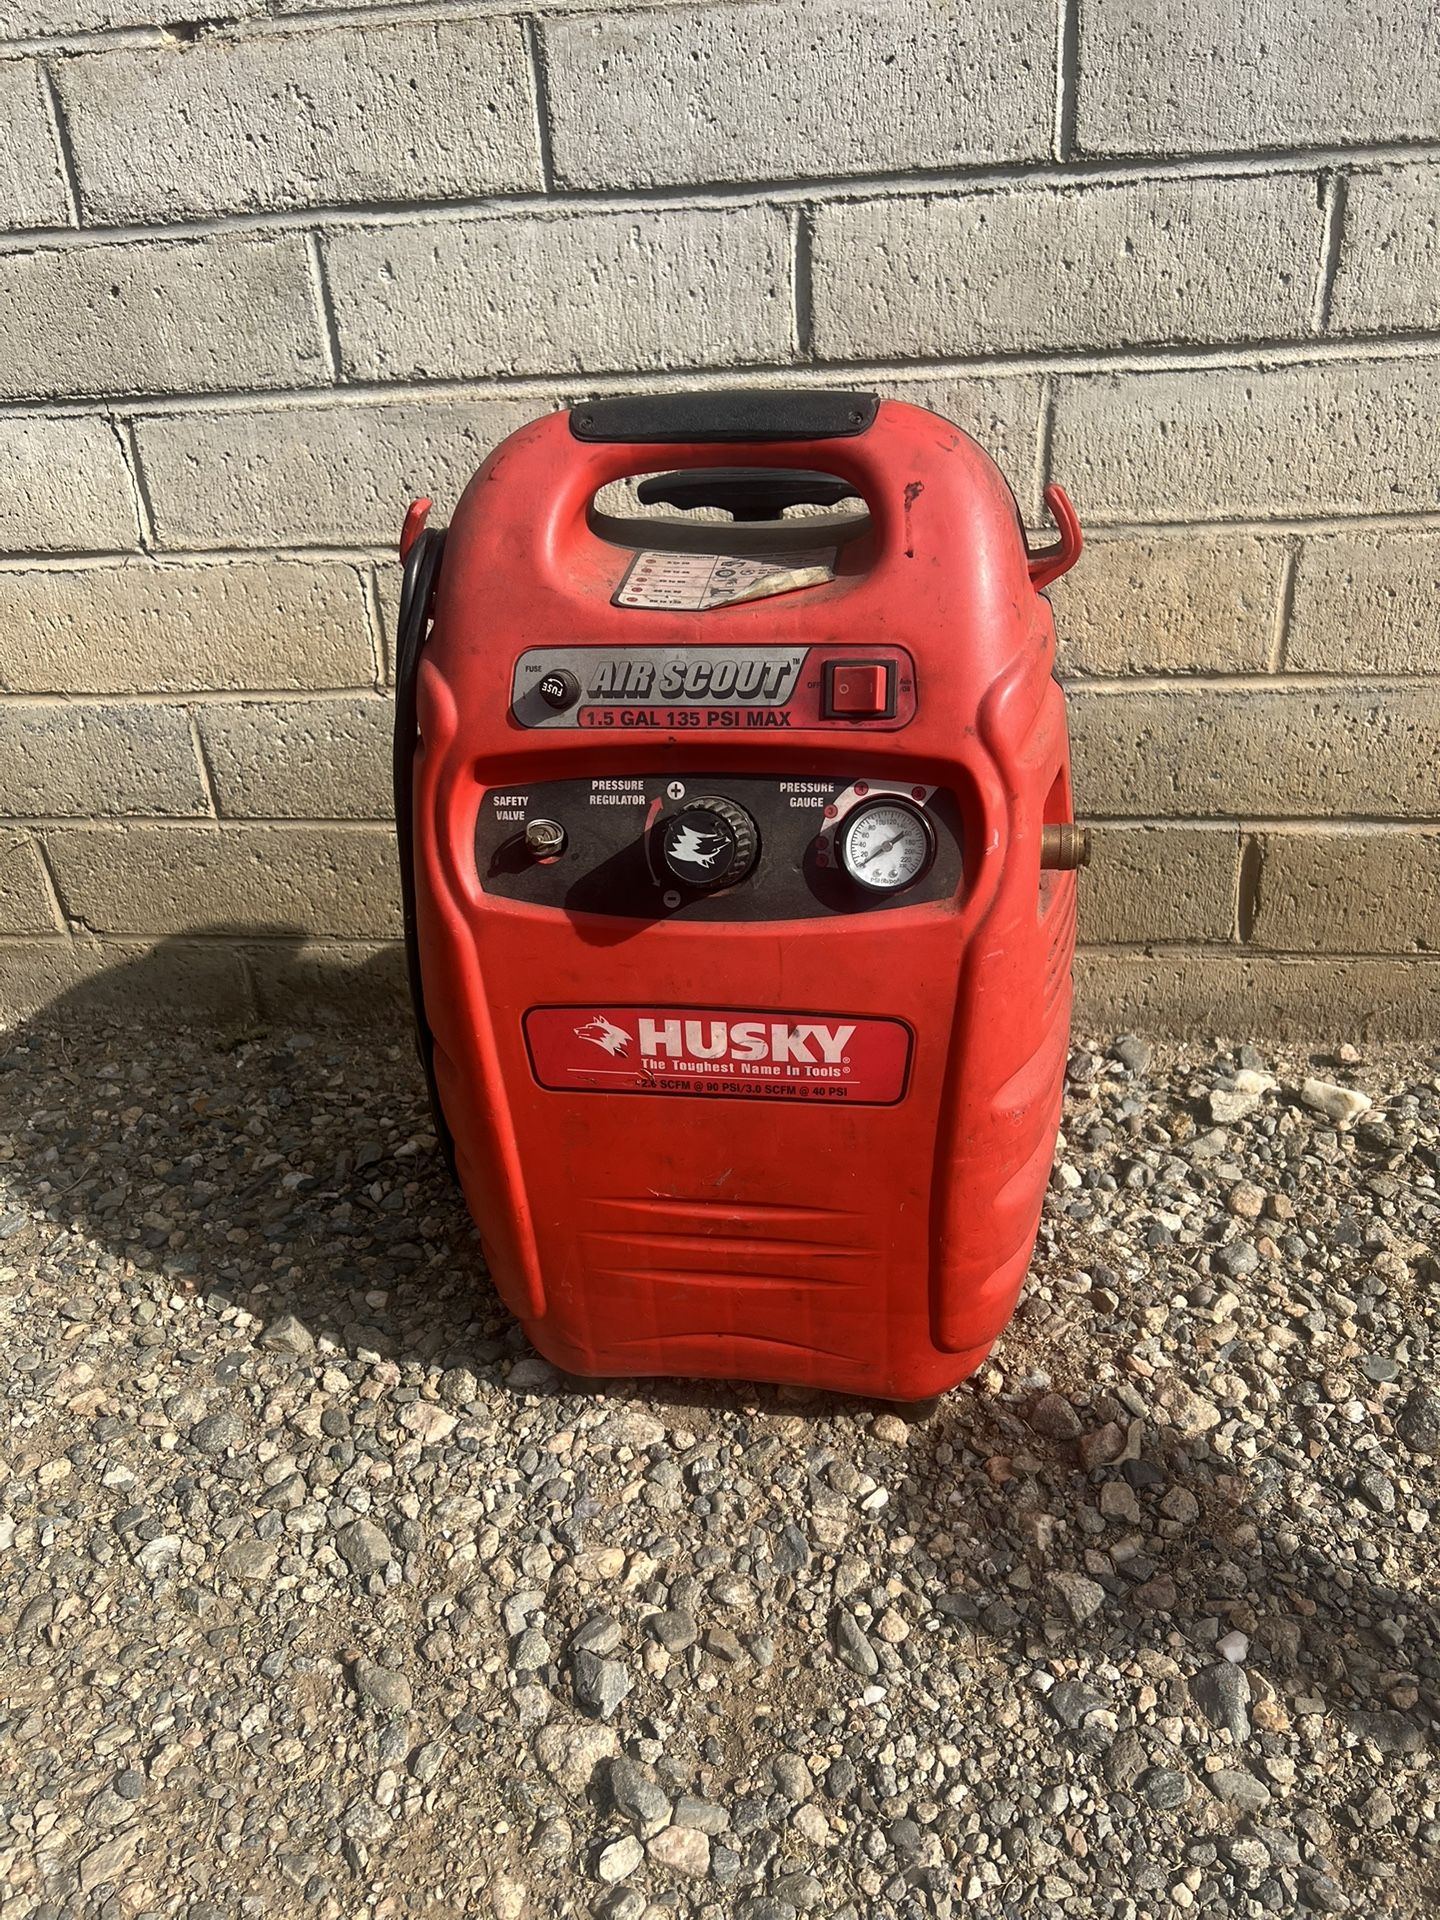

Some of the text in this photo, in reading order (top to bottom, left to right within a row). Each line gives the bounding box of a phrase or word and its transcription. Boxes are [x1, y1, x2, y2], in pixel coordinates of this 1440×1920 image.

[525, 665, 542, 673] FUSE
[586, 661, 656, 699] AIR
[659, 661, 791, 699] SCOUT
[541, 682, 563, 697] FUSE
[587, 711, 791, 726] 1.5 GAL 135 PSI MAX
[591, 780, 644, 791] PRESSURE
[779, 782, 835, 793] PRESSURE
[493, 796, 529, 807] SAFETY
[589, 795, 646, 806] REGULATOR
[789, 797, 824, 808] GAUGE
[496, 810, 525, 821] VALVE
[638, 1018, 857, 1064] HUSKY
[641, 1058, 841, 1077] The Toughest Name In Tools
[660, 1080, 690, 1089] SCFM
[694, 1081, 703, 1091] @
[707, 1082, 719, 1091] 90
[722, 1082, 762, 1094] PSI/3.0
[766, 1085, 796, 1095] SCFM
[800, 1086, 809, 1096] @
[813, 1086, 825, 1096] 40
[829, 1087, 848, 1097] PSI
